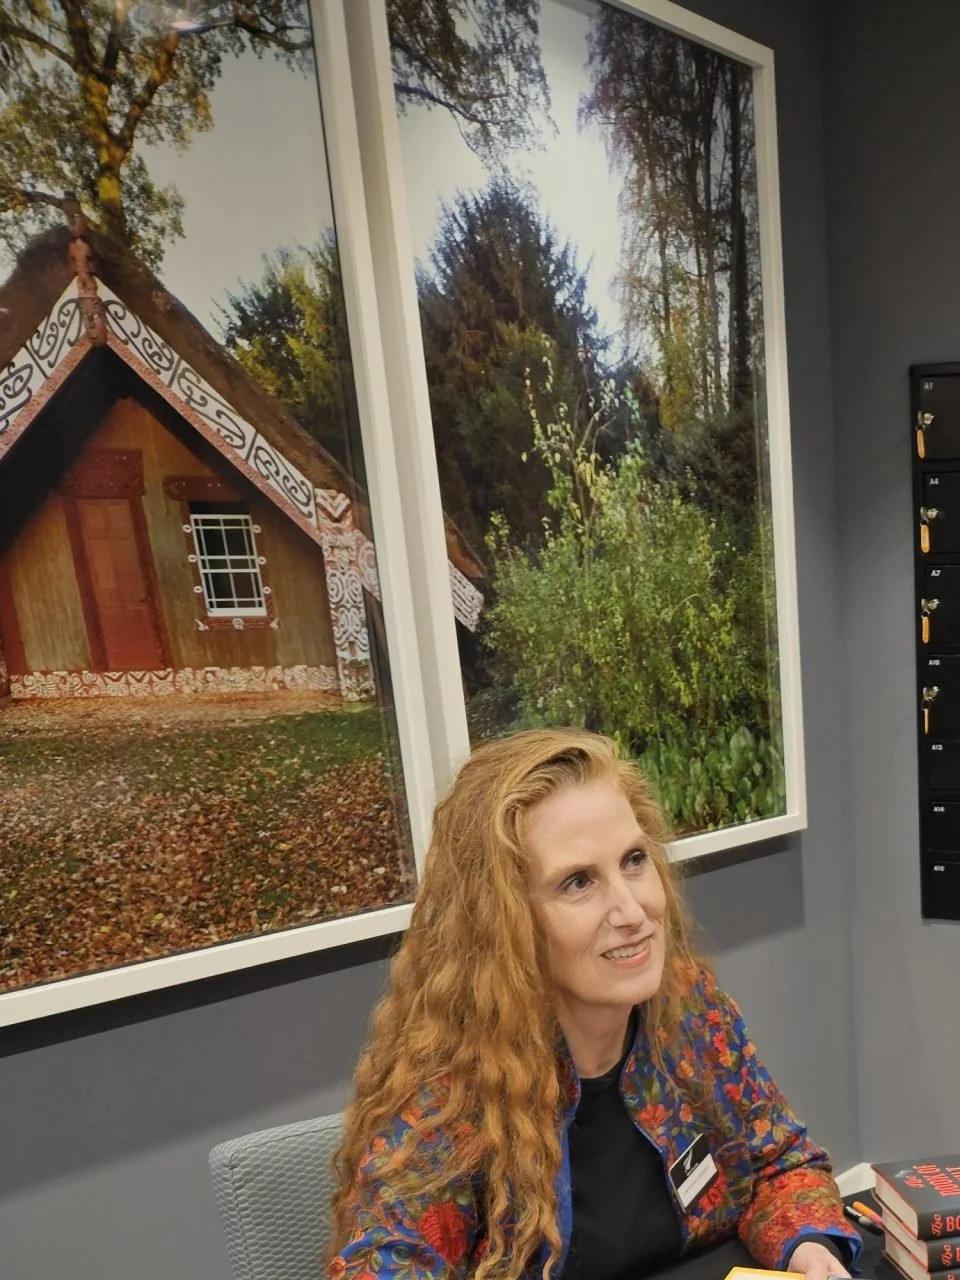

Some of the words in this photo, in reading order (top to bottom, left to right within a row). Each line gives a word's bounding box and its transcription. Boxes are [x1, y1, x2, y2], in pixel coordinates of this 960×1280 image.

[912, 1164, 940, 1174] OF
[932, 1214, 943, 1236] The
[942, 1244, 953, 1266] The
